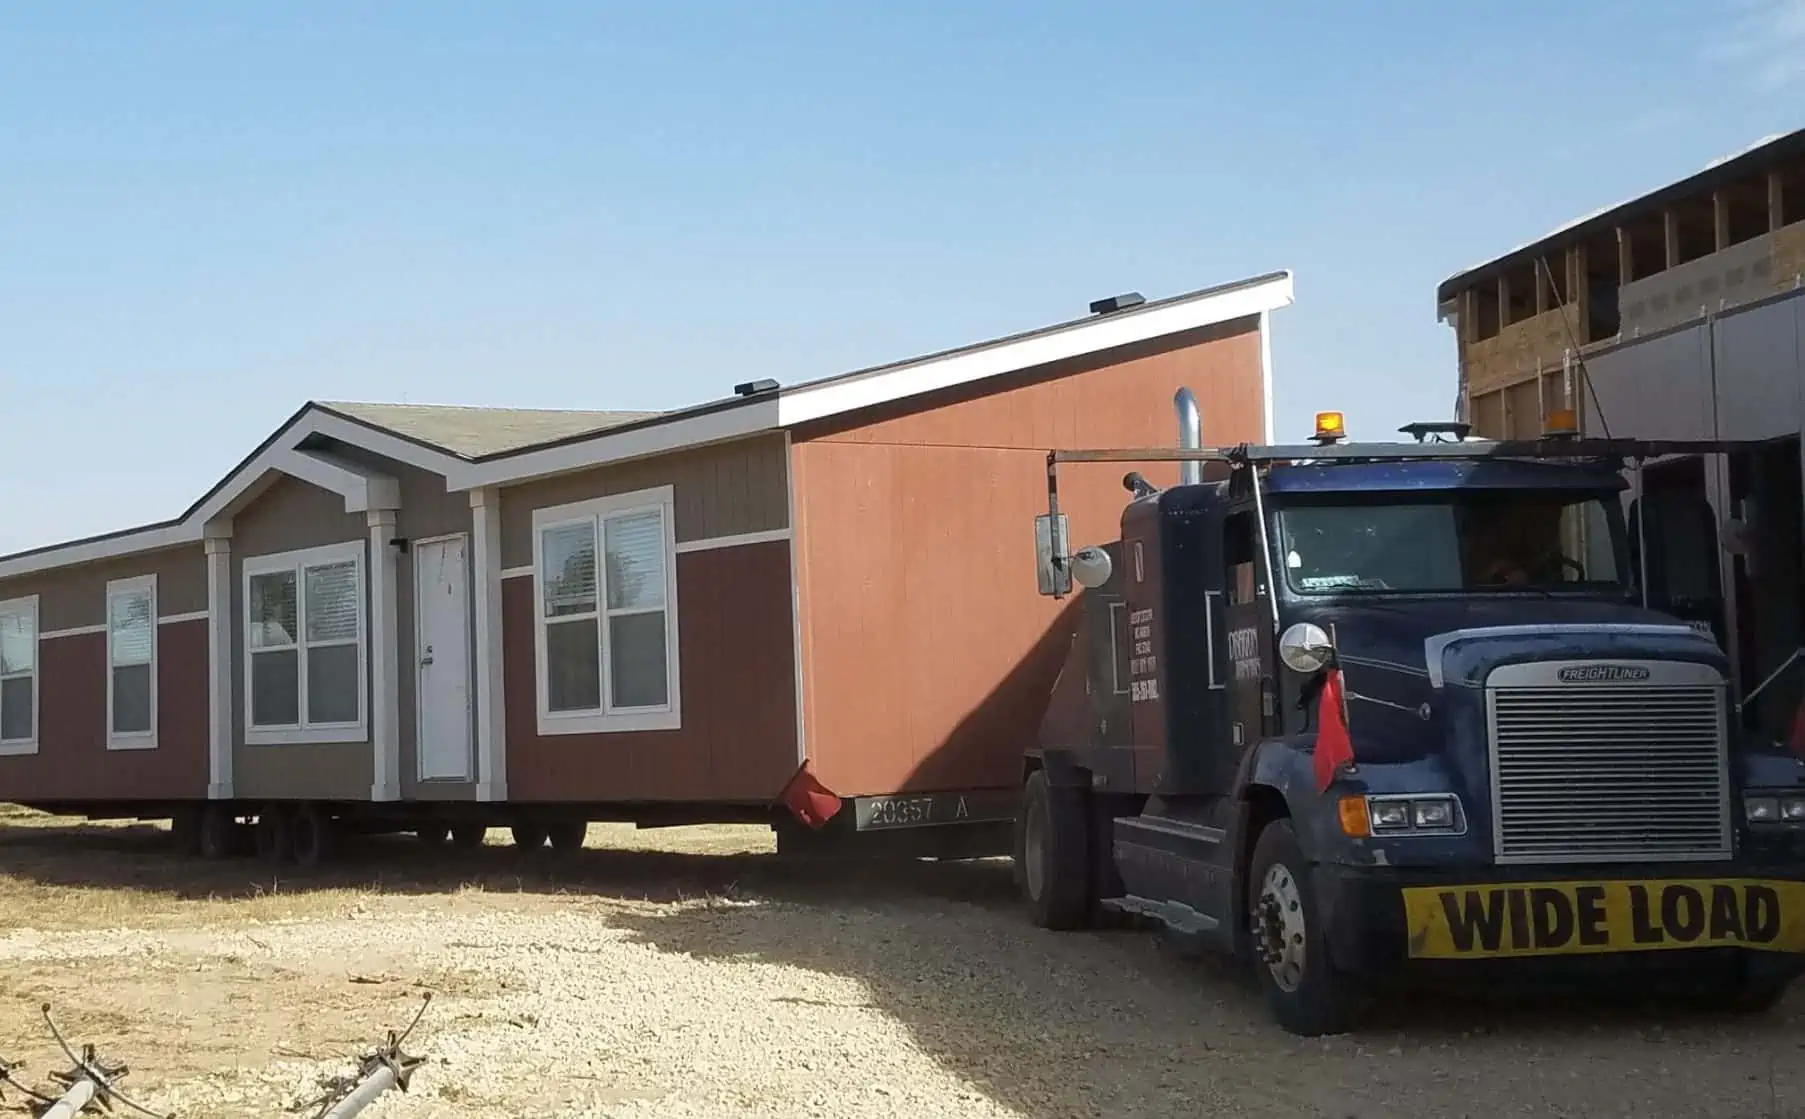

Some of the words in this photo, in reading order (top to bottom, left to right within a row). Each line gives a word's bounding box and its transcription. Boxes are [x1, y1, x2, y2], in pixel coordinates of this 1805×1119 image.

[1562, 666, 1648, 680] FREIGHTLINER
[870, 798, 933, 824] 20357
[956, 796, 969, 819] A
[1438, 886, 1610, 952] WIDE
[1629, 884, 1780, 944] LOAD
